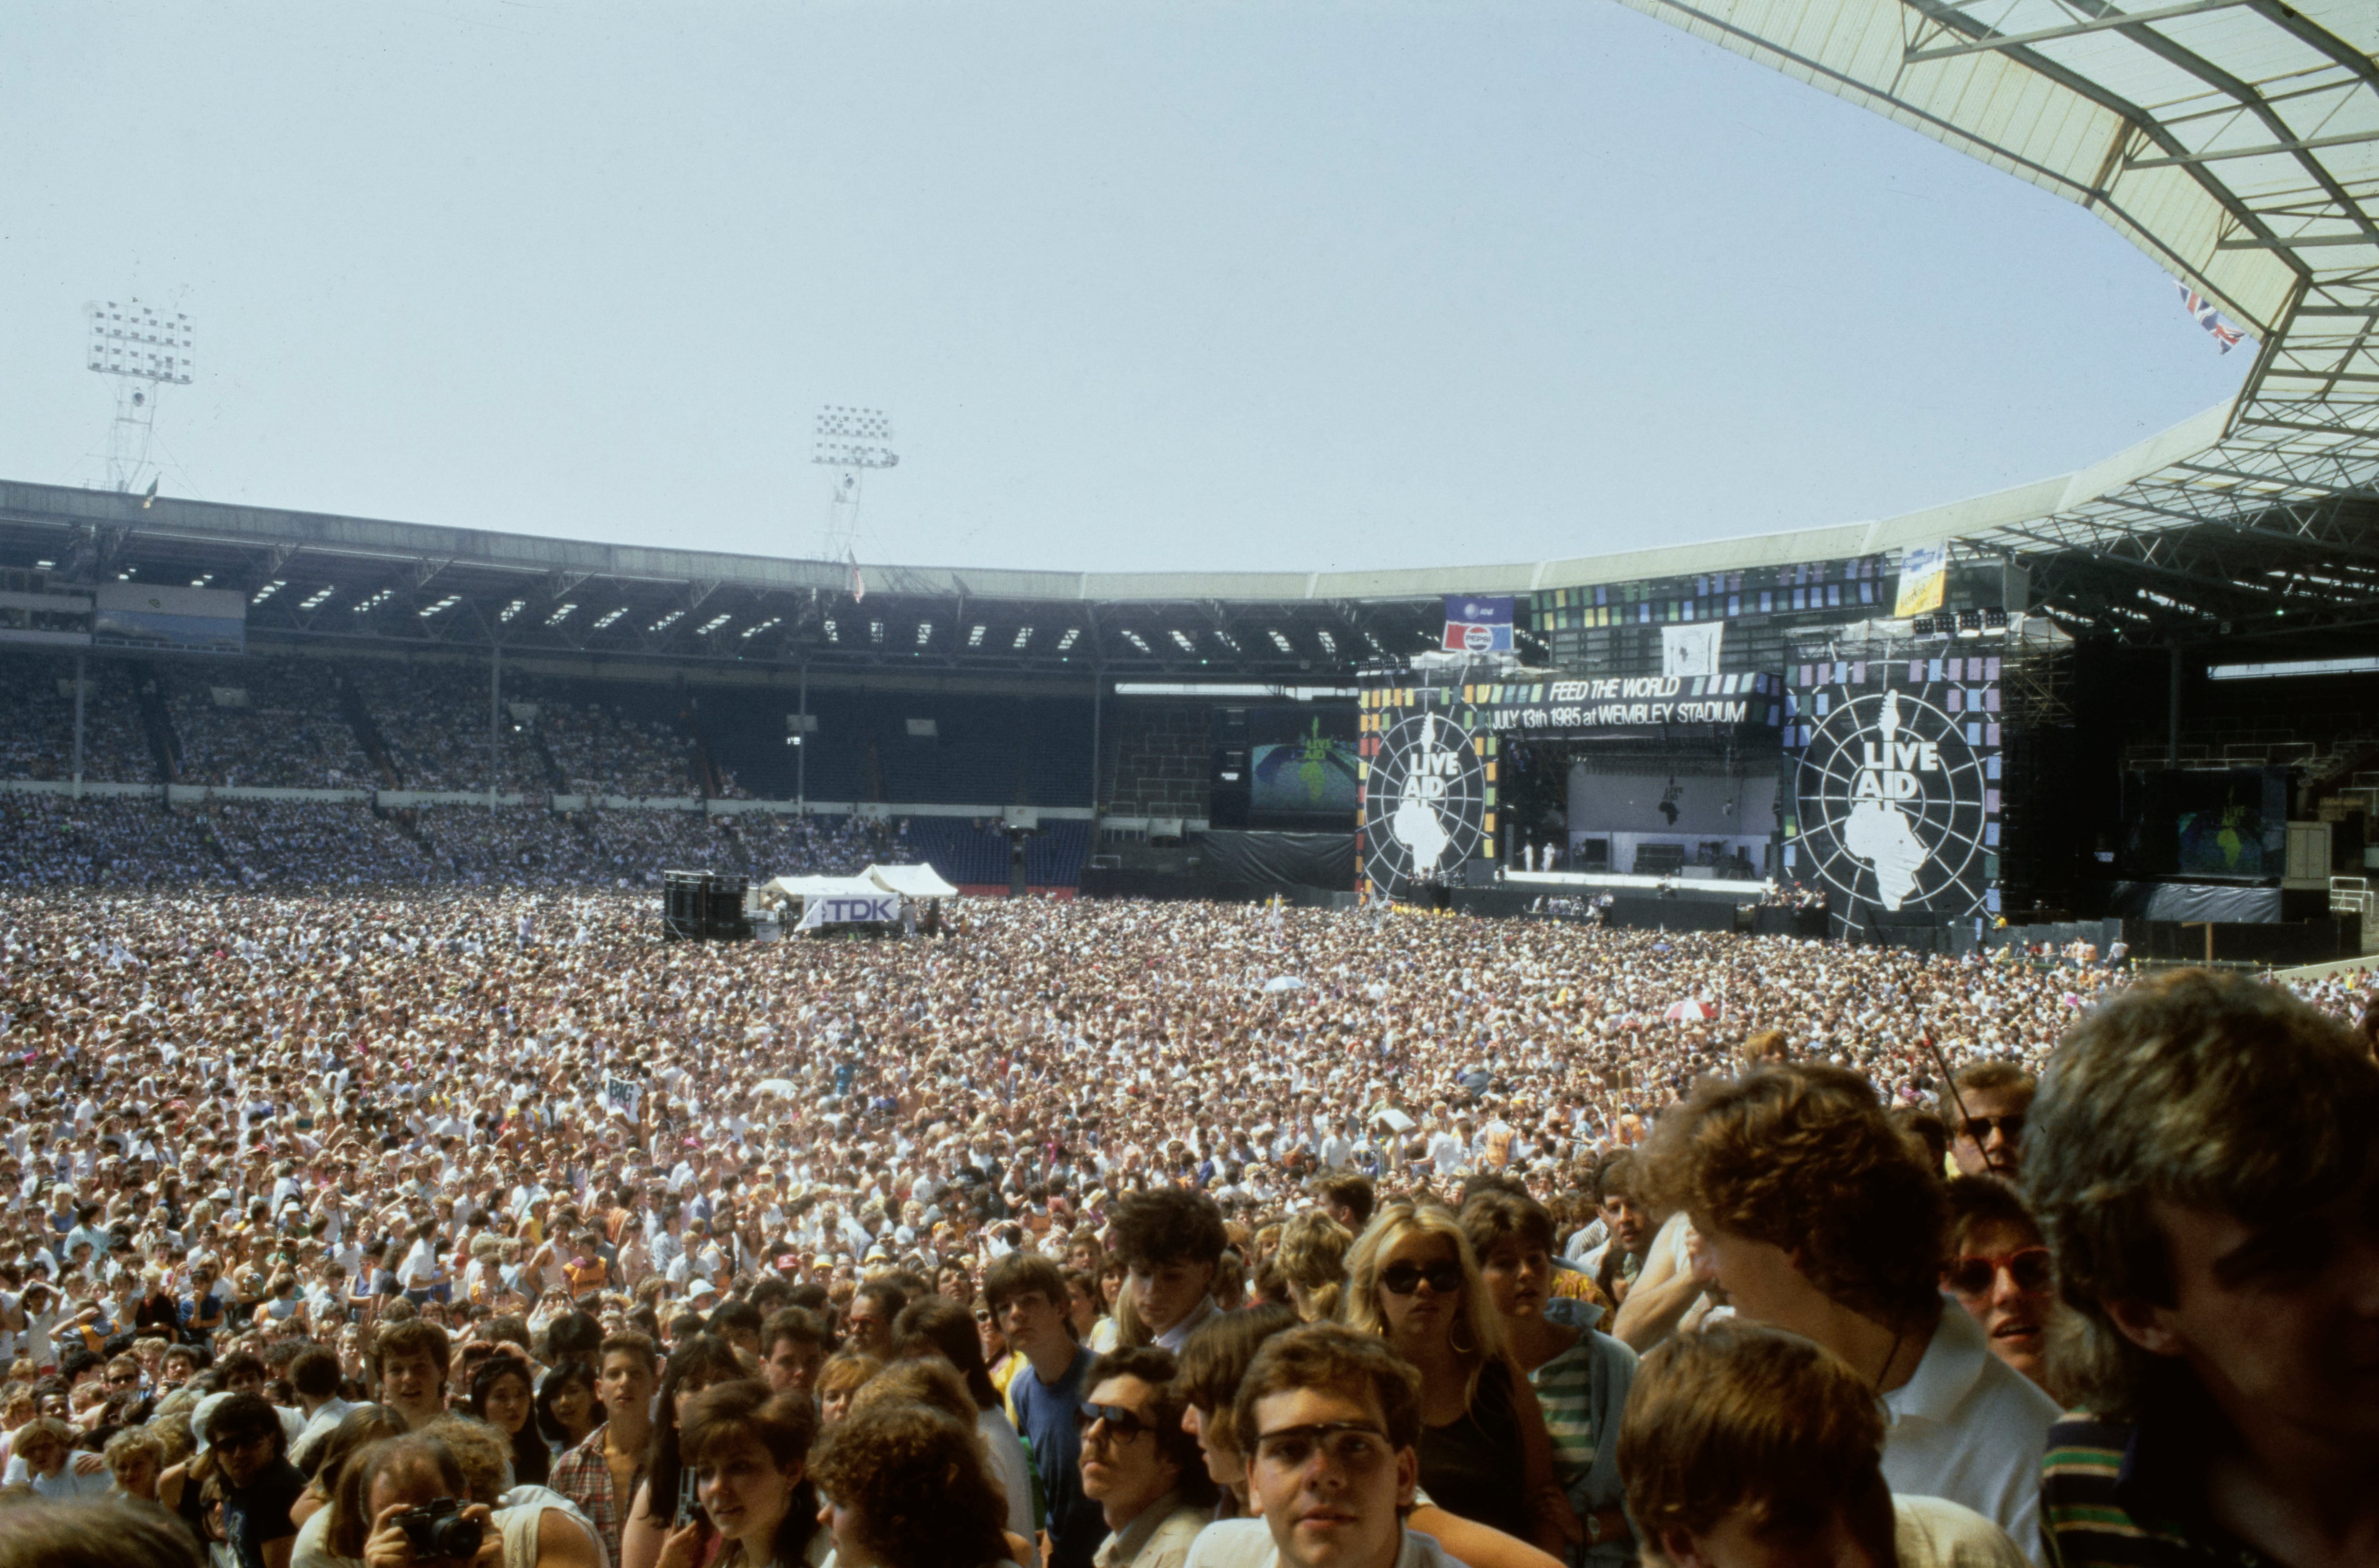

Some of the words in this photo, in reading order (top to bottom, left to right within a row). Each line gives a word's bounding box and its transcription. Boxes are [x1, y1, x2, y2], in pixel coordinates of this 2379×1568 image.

[1549, 681, 1590, 702] FEED
[1591, 678, 1621, 699] THE
[1623, 676, 1681, 698] WORLD
[1492, 709, 1519, 729] JULY
[1522, 708, 1547, 728] 13th
[1551, 706, 1581, 727] 1985
[1583, 708, 1597, 725] at
[1598, 703, 1674, 725] WEMBLEY
[1677, 701, 1747, 723] STADIUM
[1304, 749, 1326, 759] AID
[1307, 738, 1330, 749] LIVE
[1410, 752, 1458, 775] LIVE
[1864, 742, 1938, 771] LIVE
[1403, 775, 1444, 798] AID
[1856, 770, 1918, 799] AID
[827, 899, 894, 921] TDK
[609, 1078, 634, 1102] BIG
